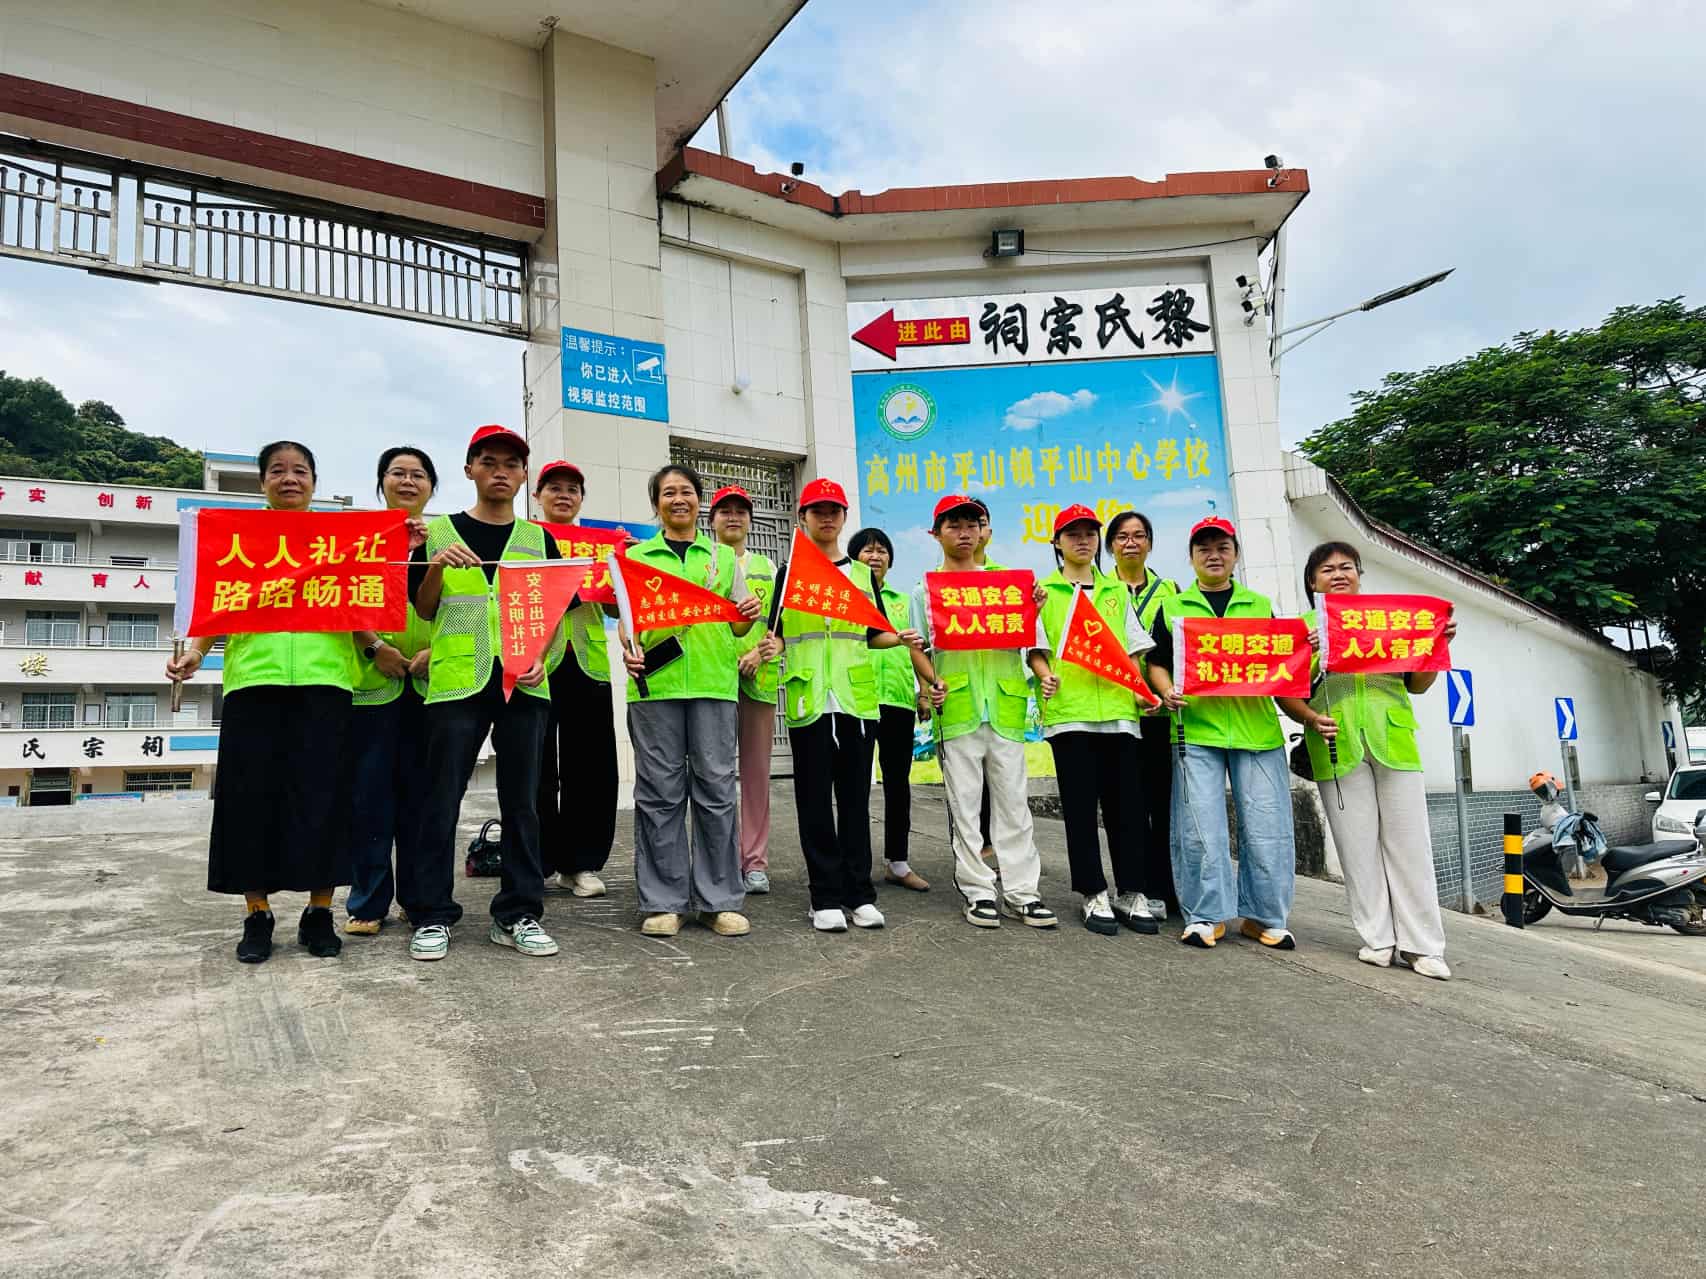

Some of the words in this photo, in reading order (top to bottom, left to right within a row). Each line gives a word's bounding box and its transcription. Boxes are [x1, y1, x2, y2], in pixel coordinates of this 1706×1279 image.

[580, 361, 633, 385] 你已进入
[567, 385, 647, 413] 视频监控范围
[865, 437, 1212, 496] 高州市平山镇平山中心学校
[97, 492, 153, 511] 创新
[216, 532, 387, 569] 人人礼让
[91, 572, 150, 590] 育人
[794, 579, 852, 602] 文明交通
[211, 575, 386, 613] 路路畅通
[789, 592, 849, 615] 安全出行
[940, 585, 1024, 607] 交通安全
[944, 613, 1025, 635] 人人有责
[1341, 609, 1436, 631] 交通安全
[1197, 633, 1295, 656] 文明交通
[1341, 637, 1435, 659] 人人有责
[1196, 661, 1294, 684] 礼让行人
